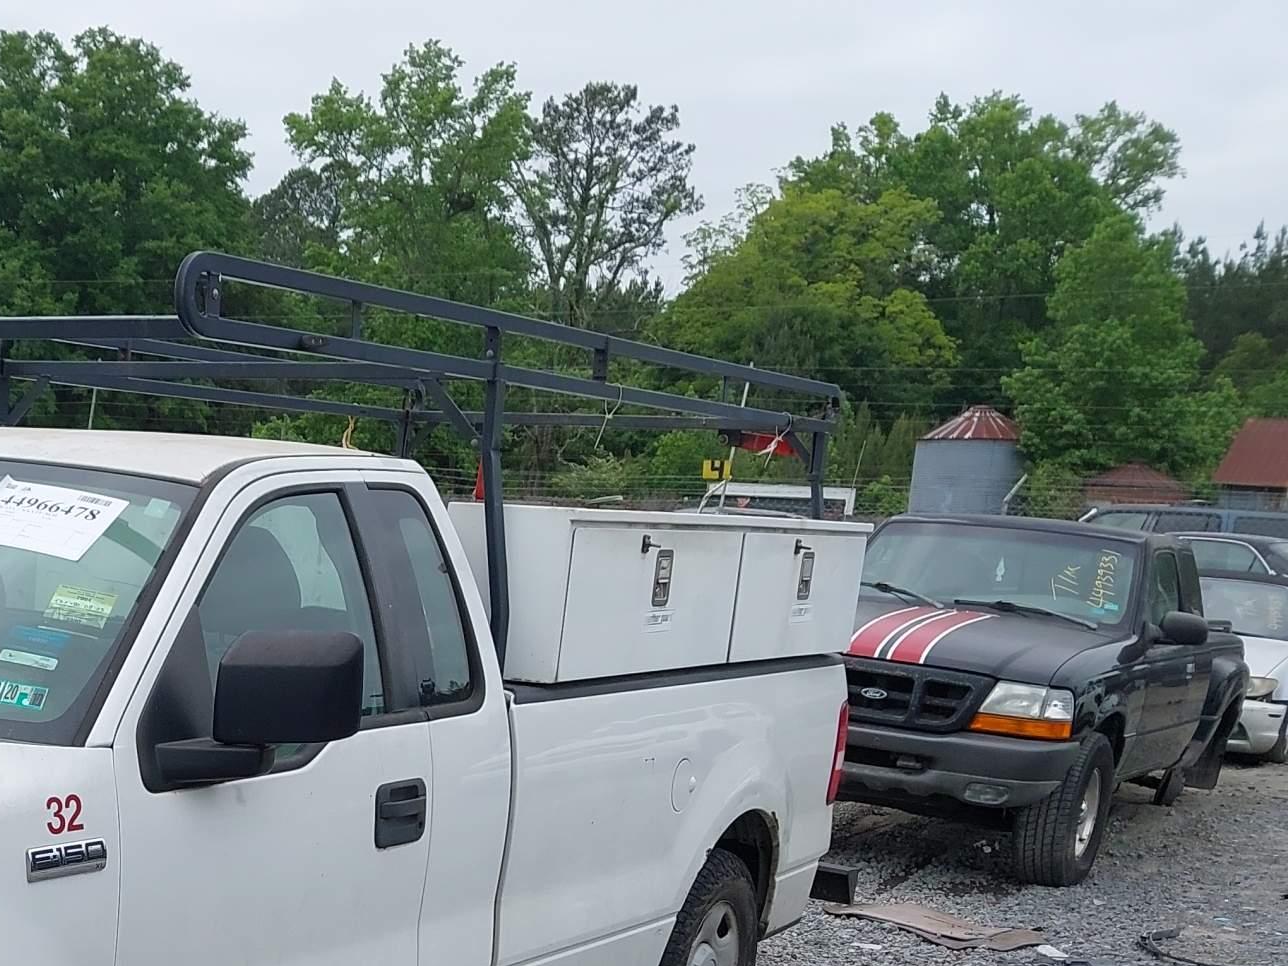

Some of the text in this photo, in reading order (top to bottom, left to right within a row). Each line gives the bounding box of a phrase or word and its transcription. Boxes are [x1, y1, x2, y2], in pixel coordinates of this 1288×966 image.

[0, 495, 101, 521] 44966478
[4, 684, 19, 700] 20
[46, 793, 85, 835] 32
